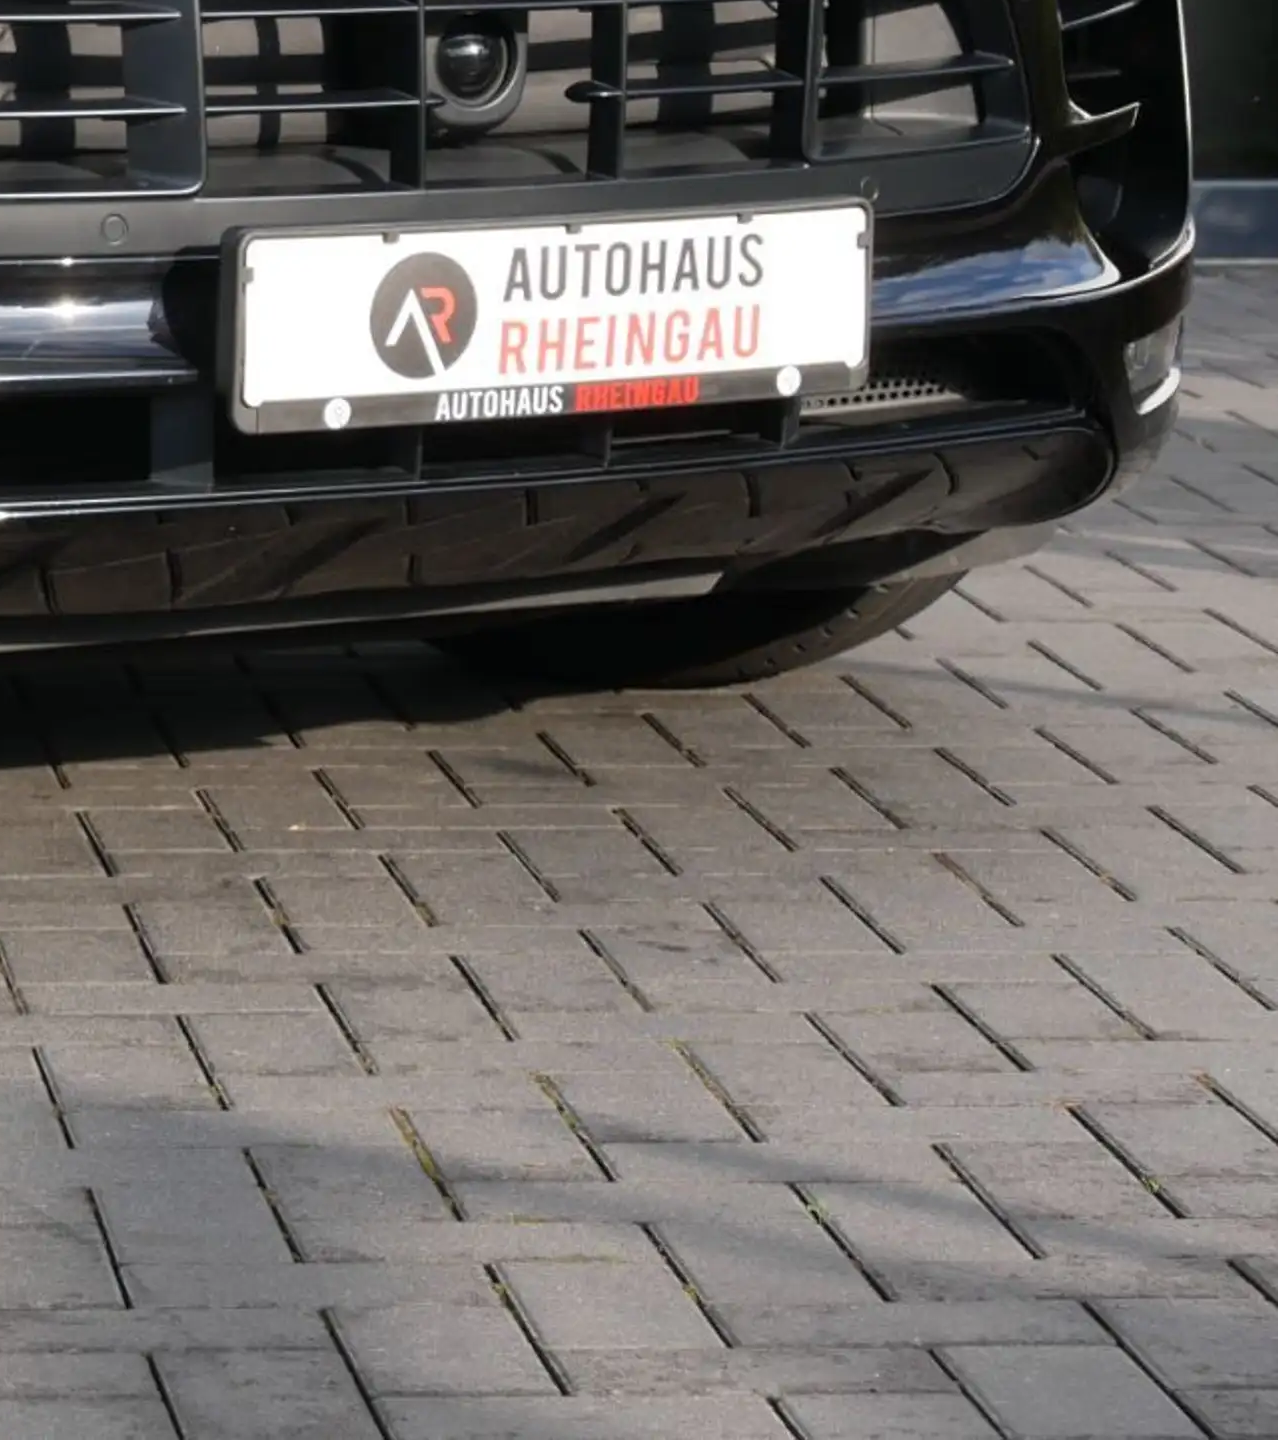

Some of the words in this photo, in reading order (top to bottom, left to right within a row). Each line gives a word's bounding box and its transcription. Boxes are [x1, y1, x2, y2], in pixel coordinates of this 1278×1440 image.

[502, 232, 764, 303] AUTOHAUS
[497, 303, 762, 375] RHEINGAU
[434, 384, 565, 422] AUTOHAUS
